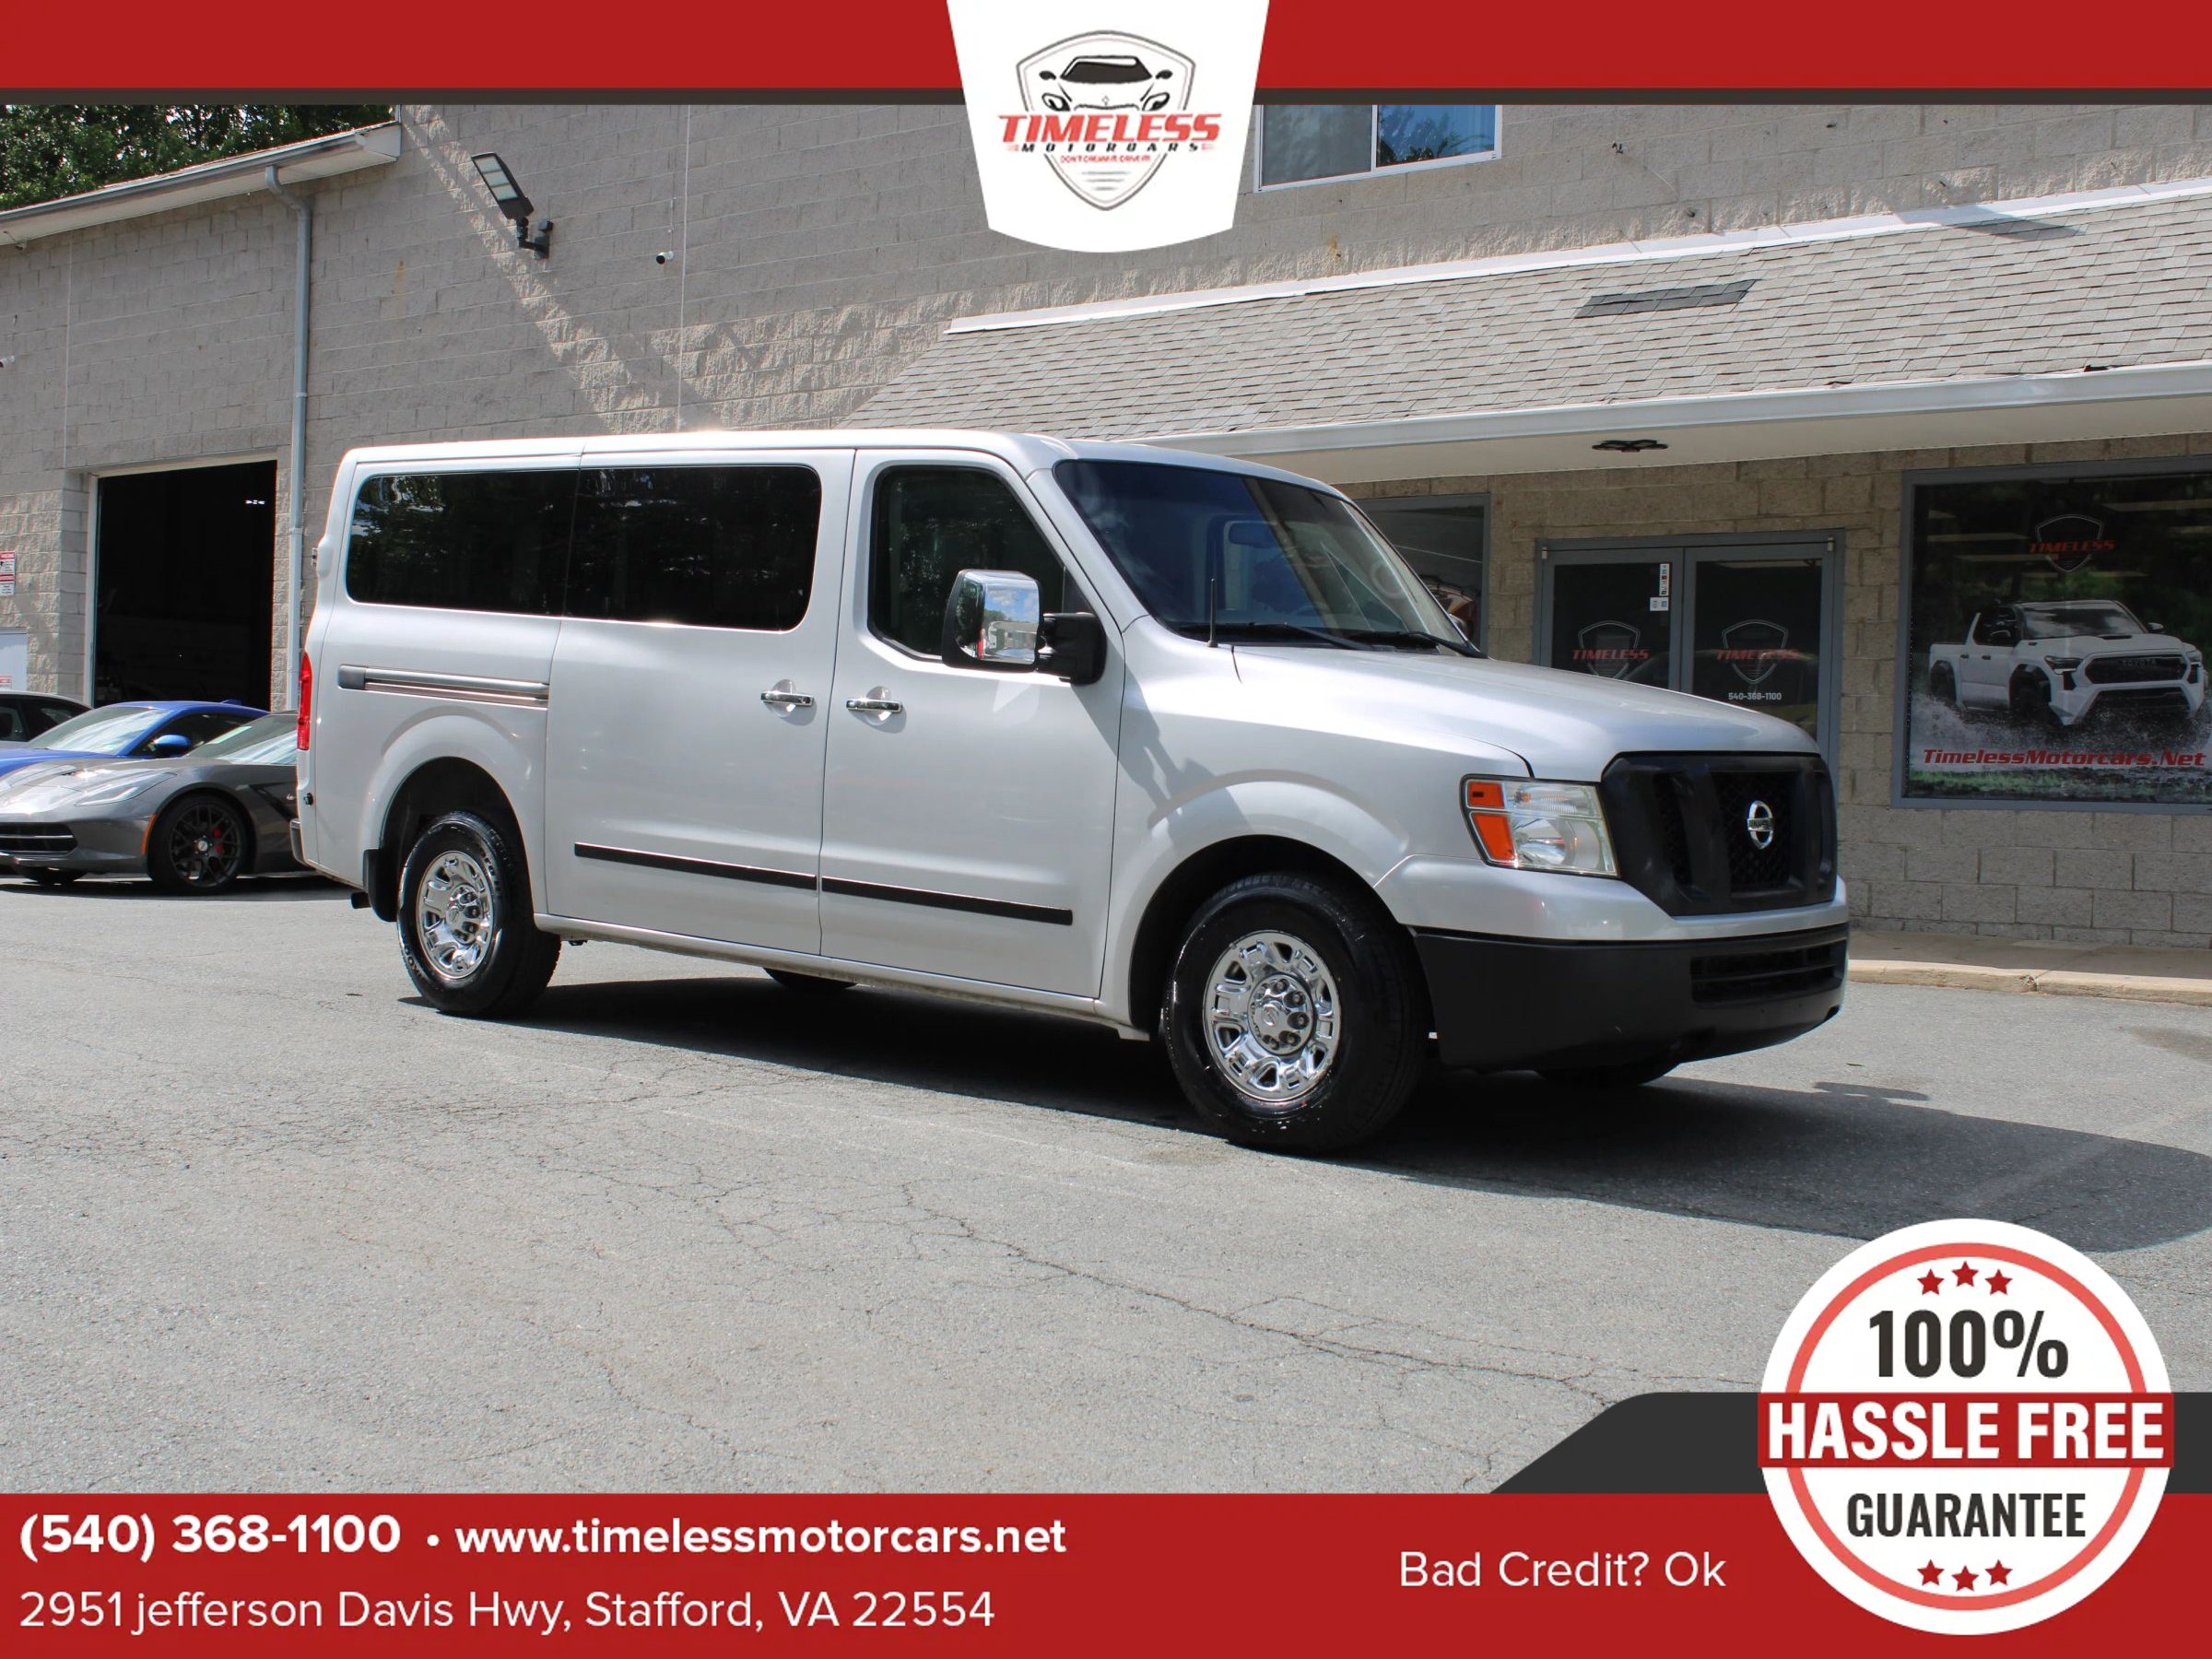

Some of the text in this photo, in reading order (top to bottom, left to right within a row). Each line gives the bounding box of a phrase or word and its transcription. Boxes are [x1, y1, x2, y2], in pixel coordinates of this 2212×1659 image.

[2030, 539, 2116, 553] TIMELESS
[1572, 649, 1650, 660] TIMELESS
[1728, 692, 1783, 700] 540-368-1100
[1924, 749, 2206, 767] TimelessMotorcars.Net
